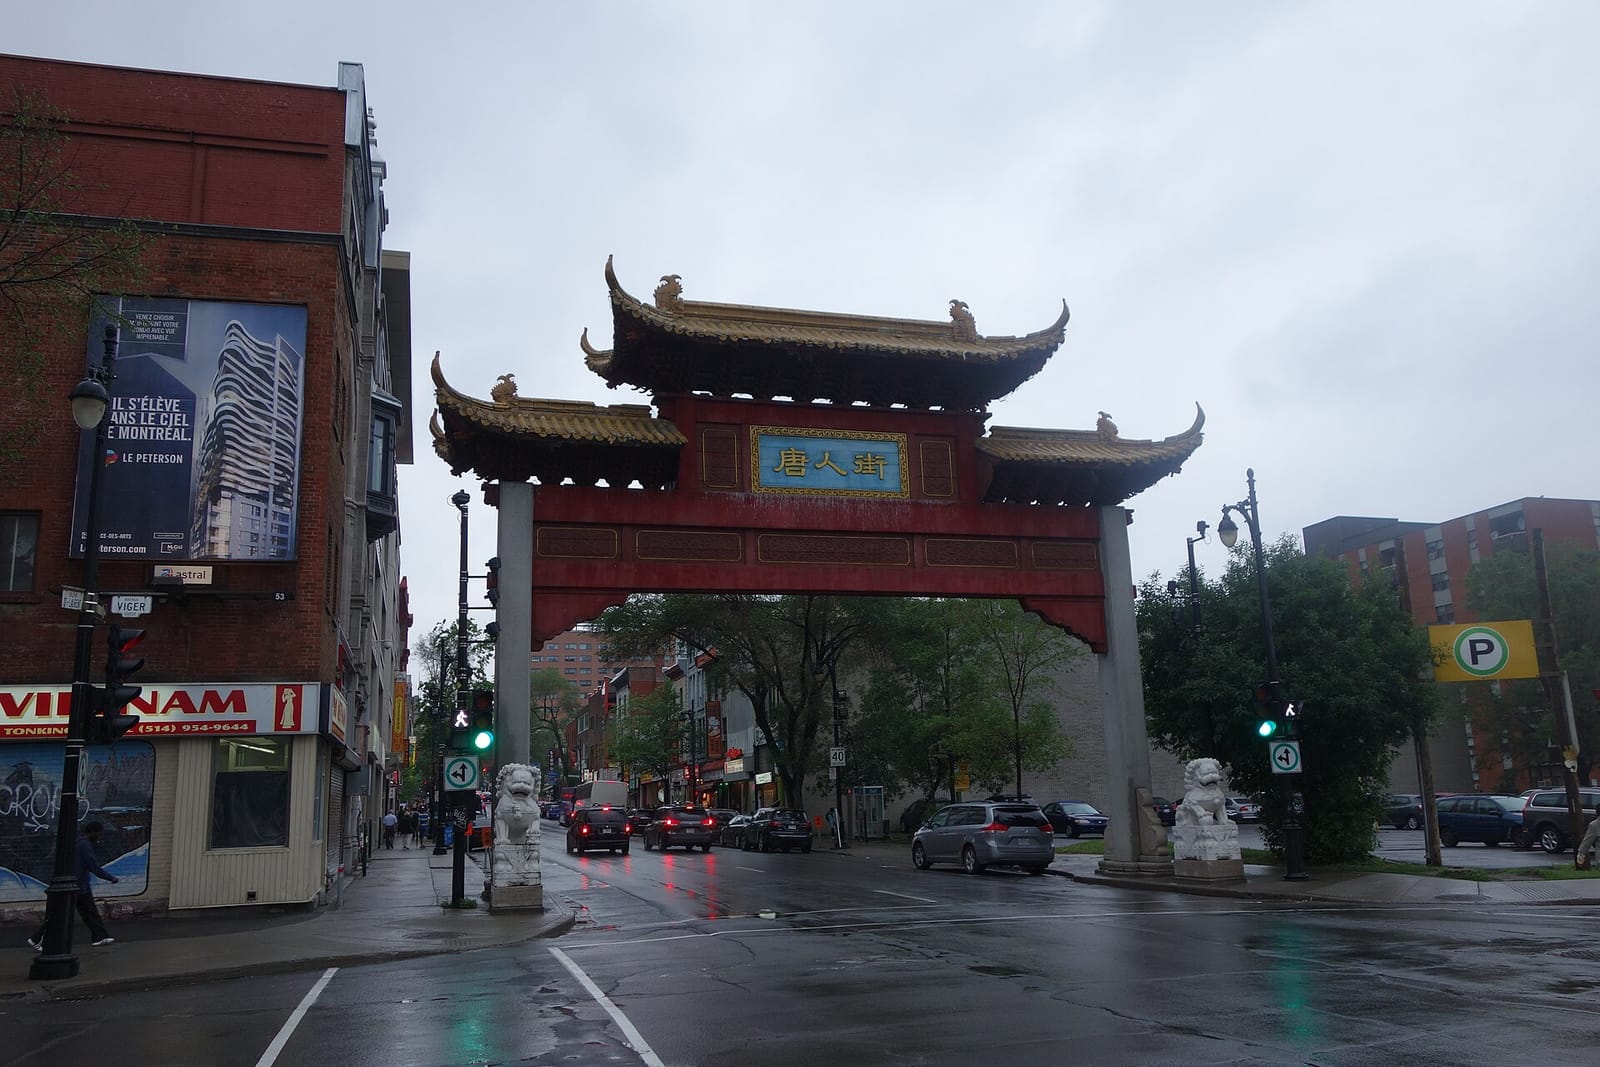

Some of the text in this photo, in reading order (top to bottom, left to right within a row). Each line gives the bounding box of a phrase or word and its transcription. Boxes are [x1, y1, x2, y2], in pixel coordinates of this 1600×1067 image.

[112, 395, 180, 412] IL S'ÉLÈVE
[111, 411, 189, 426] ANS LE CIEL
[118, 424, 192, 441] MONTRÉAL.
[122, 453, 183, 464] LE PETERSON
[773, 447, 888, 480] 唐人街
[176, 570, 206, 580] astral
[117, 602, 146, 612] VIGER
[1468, 638, 1495, 666] P
[138, 724, 177, 734] (514)
[182, 723, 249, 732] 954-9644
[832, 751, 844, 762] 40
